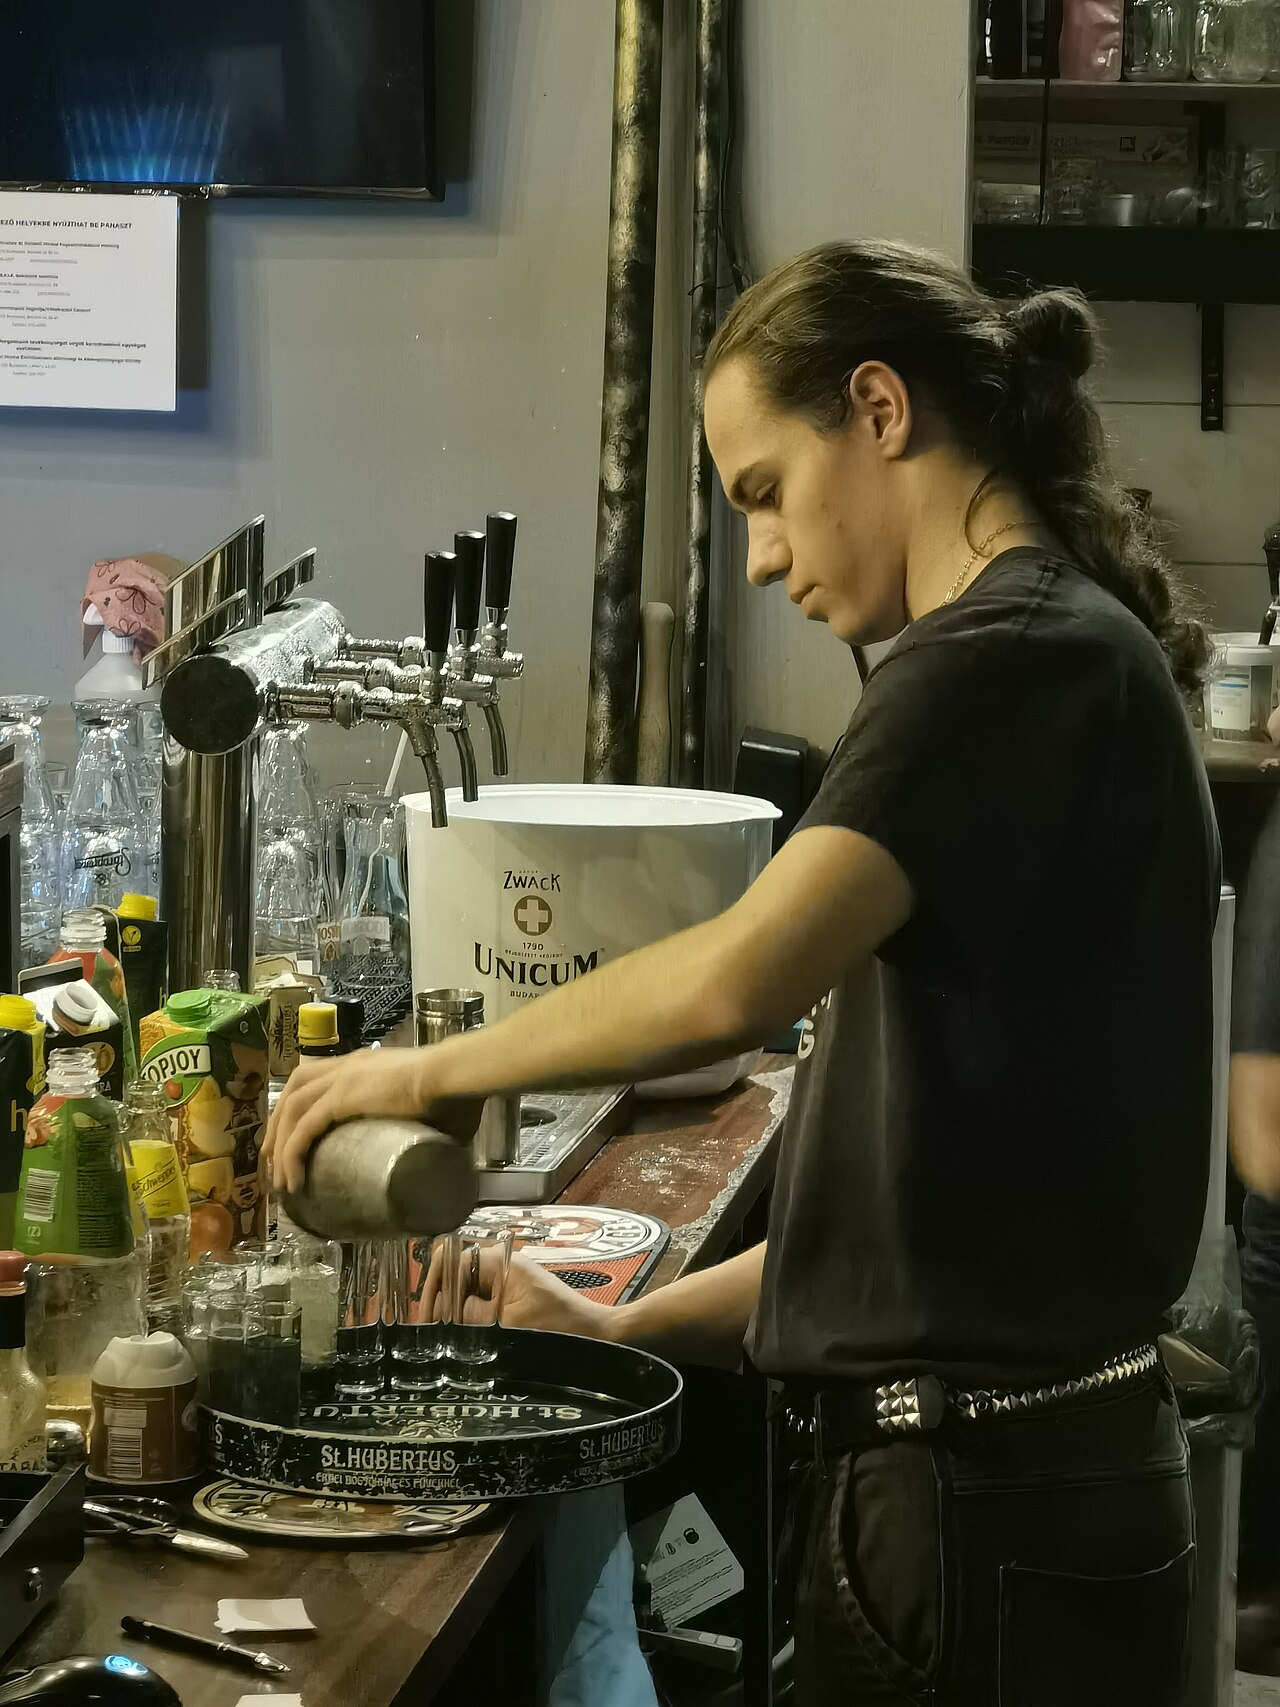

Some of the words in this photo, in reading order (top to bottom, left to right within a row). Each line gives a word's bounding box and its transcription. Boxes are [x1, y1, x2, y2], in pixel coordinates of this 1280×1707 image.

[503, 870, 561, 892] ZWACK
[522, 942, 544, 951] 1790
[474, 942, 598, 986] UNICUM
[510, 990, 544, 999] BUDAP
